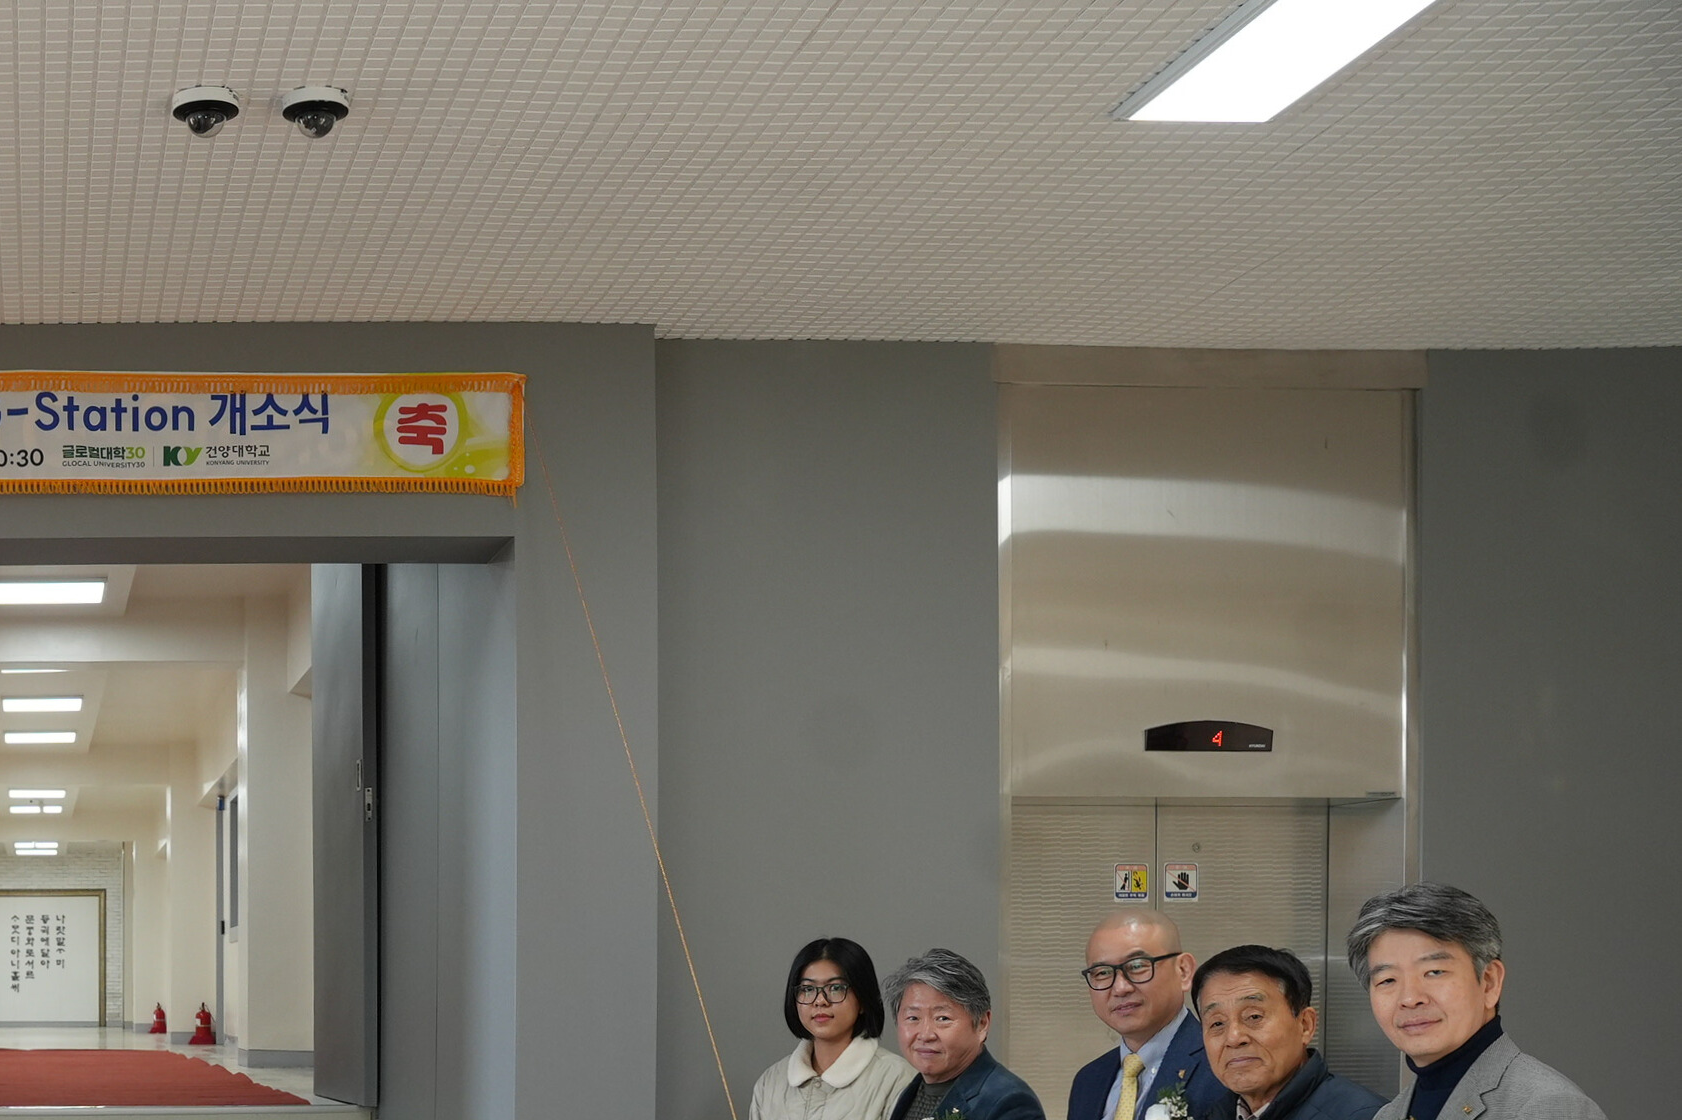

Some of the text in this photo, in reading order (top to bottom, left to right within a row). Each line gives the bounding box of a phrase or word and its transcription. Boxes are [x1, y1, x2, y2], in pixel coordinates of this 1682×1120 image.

[209, 390, 330, 436] 개소식
[396, 403, 447, 454] 축
[62, 445, 146, 460] 글로컬대학30
[205, 445, 271, 459] 건양대학교
[93, 460, 146, 469] UNIVERSITY30
[1211, 730, 1223, 747] 4
